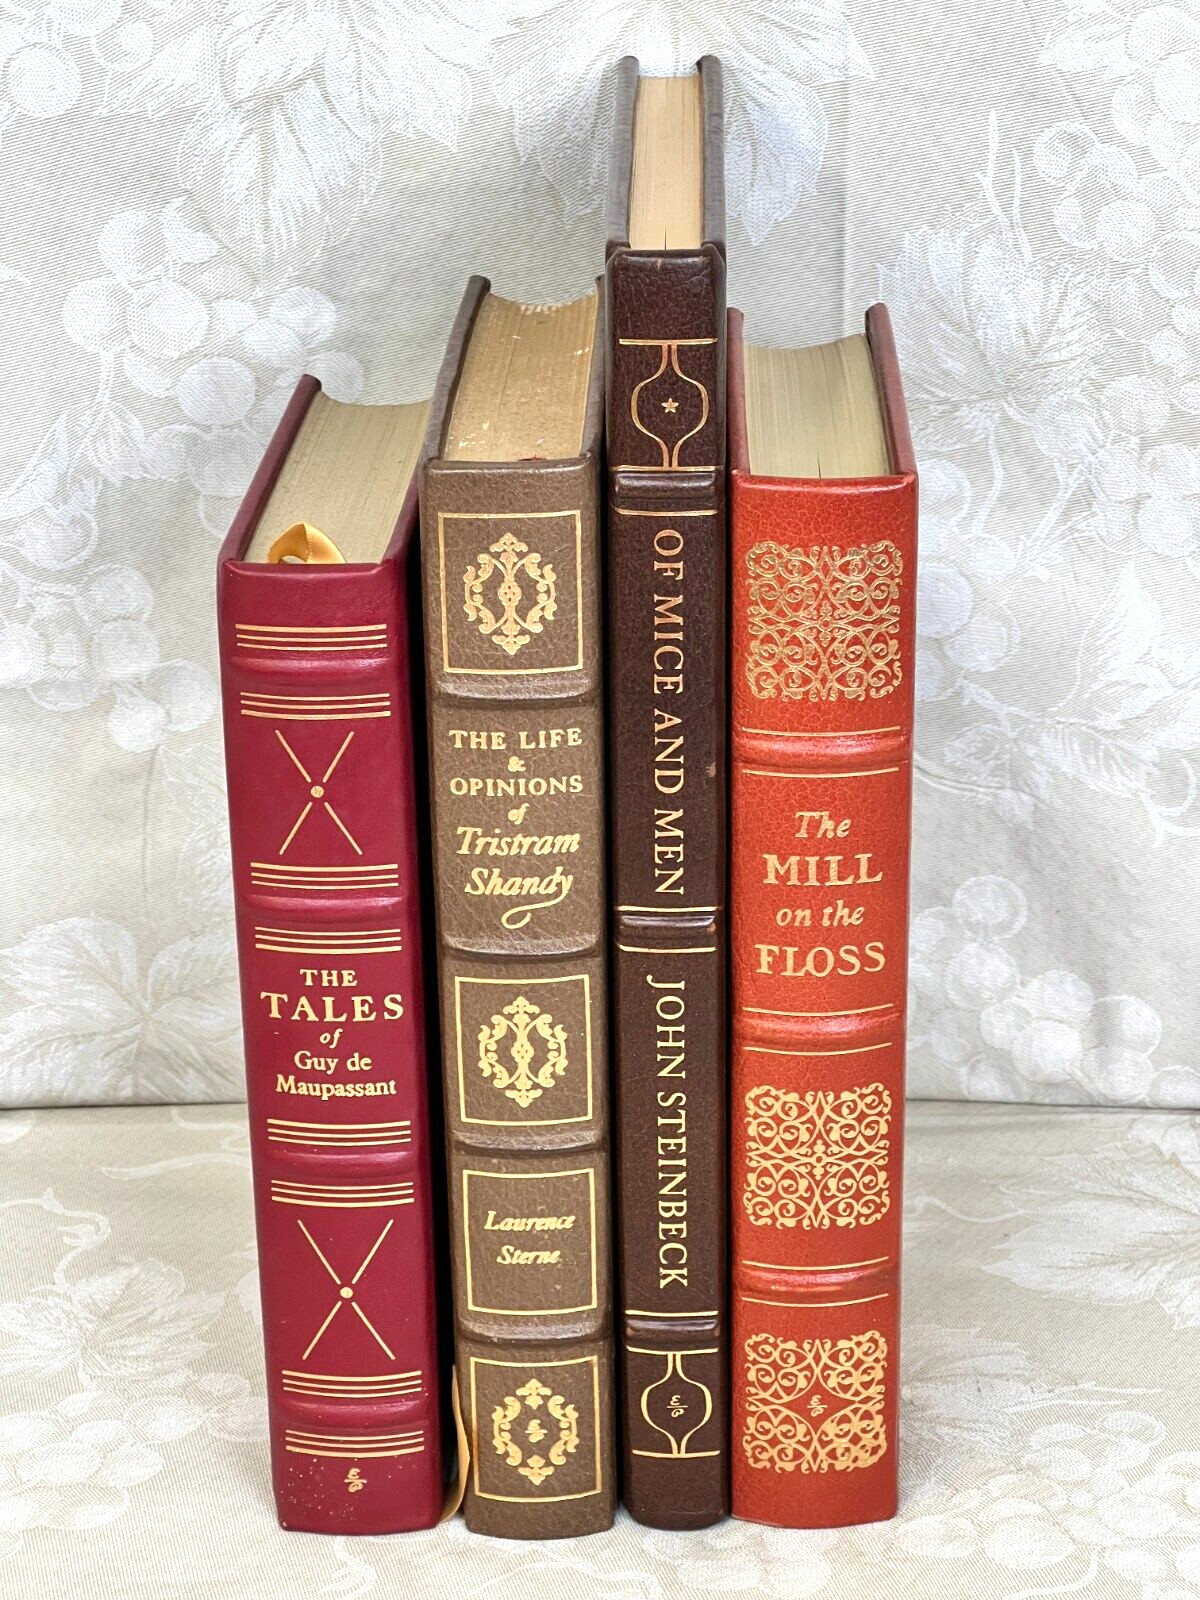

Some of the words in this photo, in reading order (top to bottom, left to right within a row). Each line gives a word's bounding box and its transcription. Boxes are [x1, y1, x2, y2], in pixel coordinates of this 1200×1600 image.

[653, 529, 684, 580] OF
[653, 594, 684, 695] MICE
[449, 729, 507, 750] THE
[519, 727, 582, 749] LIFE
[654, 708, 684, 795] AND
[507, 756, 526, 772] &
[450, 775, 583, 796] OPINIONS
[507, 803, 529, 825] of
[795, 811, 851, 838] The
[456, 826, 581, 856] Tristram
[654, 808, 684, 895] MEN
[762, 853, 883, 886] MILL
[464, 866, 573, 929] Shandy
[776, 908, 812, 926] on
[822, 900, 865, 927] the
[754, 941, 886, 977] FLOSS
[299, 969, 358, 987] THE
[260, 991, 404, 1022] TALES
[319, 1028, 343, 1049] of
[646, 974, 685, 1079] JOHN
[294, 1050, 338, 1075] Guy
[346, 1052, 372, 1071] de
[275, 1074, 397, 1100] Maupassant
[657, 1091, 688, 1289] STEINBECK
[484, 1210, 576, 1231] Laurence
[496, 1245, 561, 1264] Sterne
